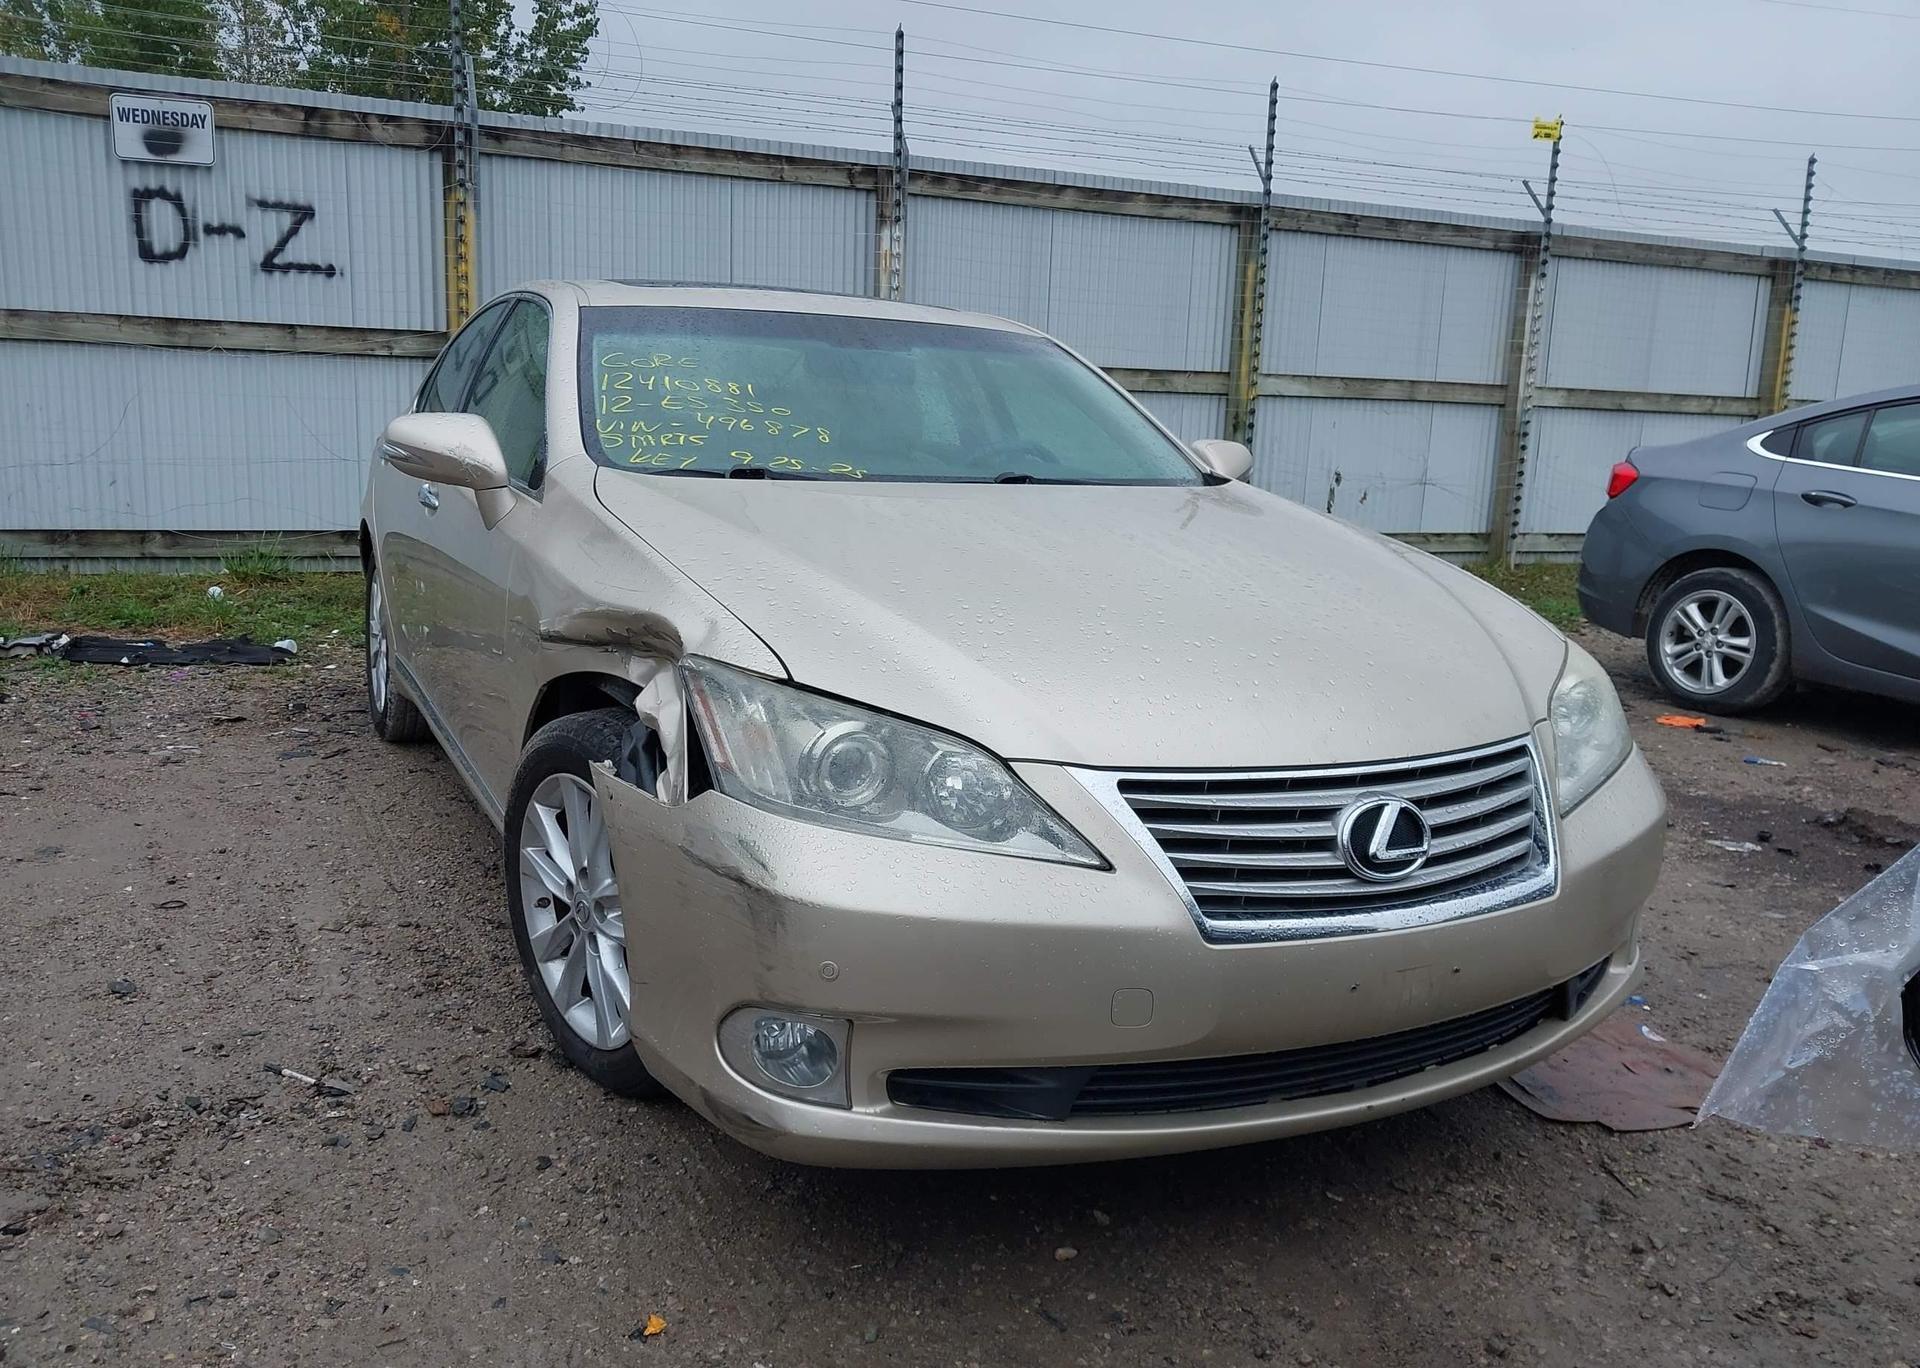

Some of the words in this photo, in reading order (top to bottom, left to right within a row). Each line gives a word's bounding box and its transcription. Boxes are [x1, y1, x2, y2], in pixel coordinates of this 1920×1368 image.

[117, 106, 207, 130] WEDNESDAY
[601, 372, 756, 398] 12410881
[629, 447, 698, 469] KEY
